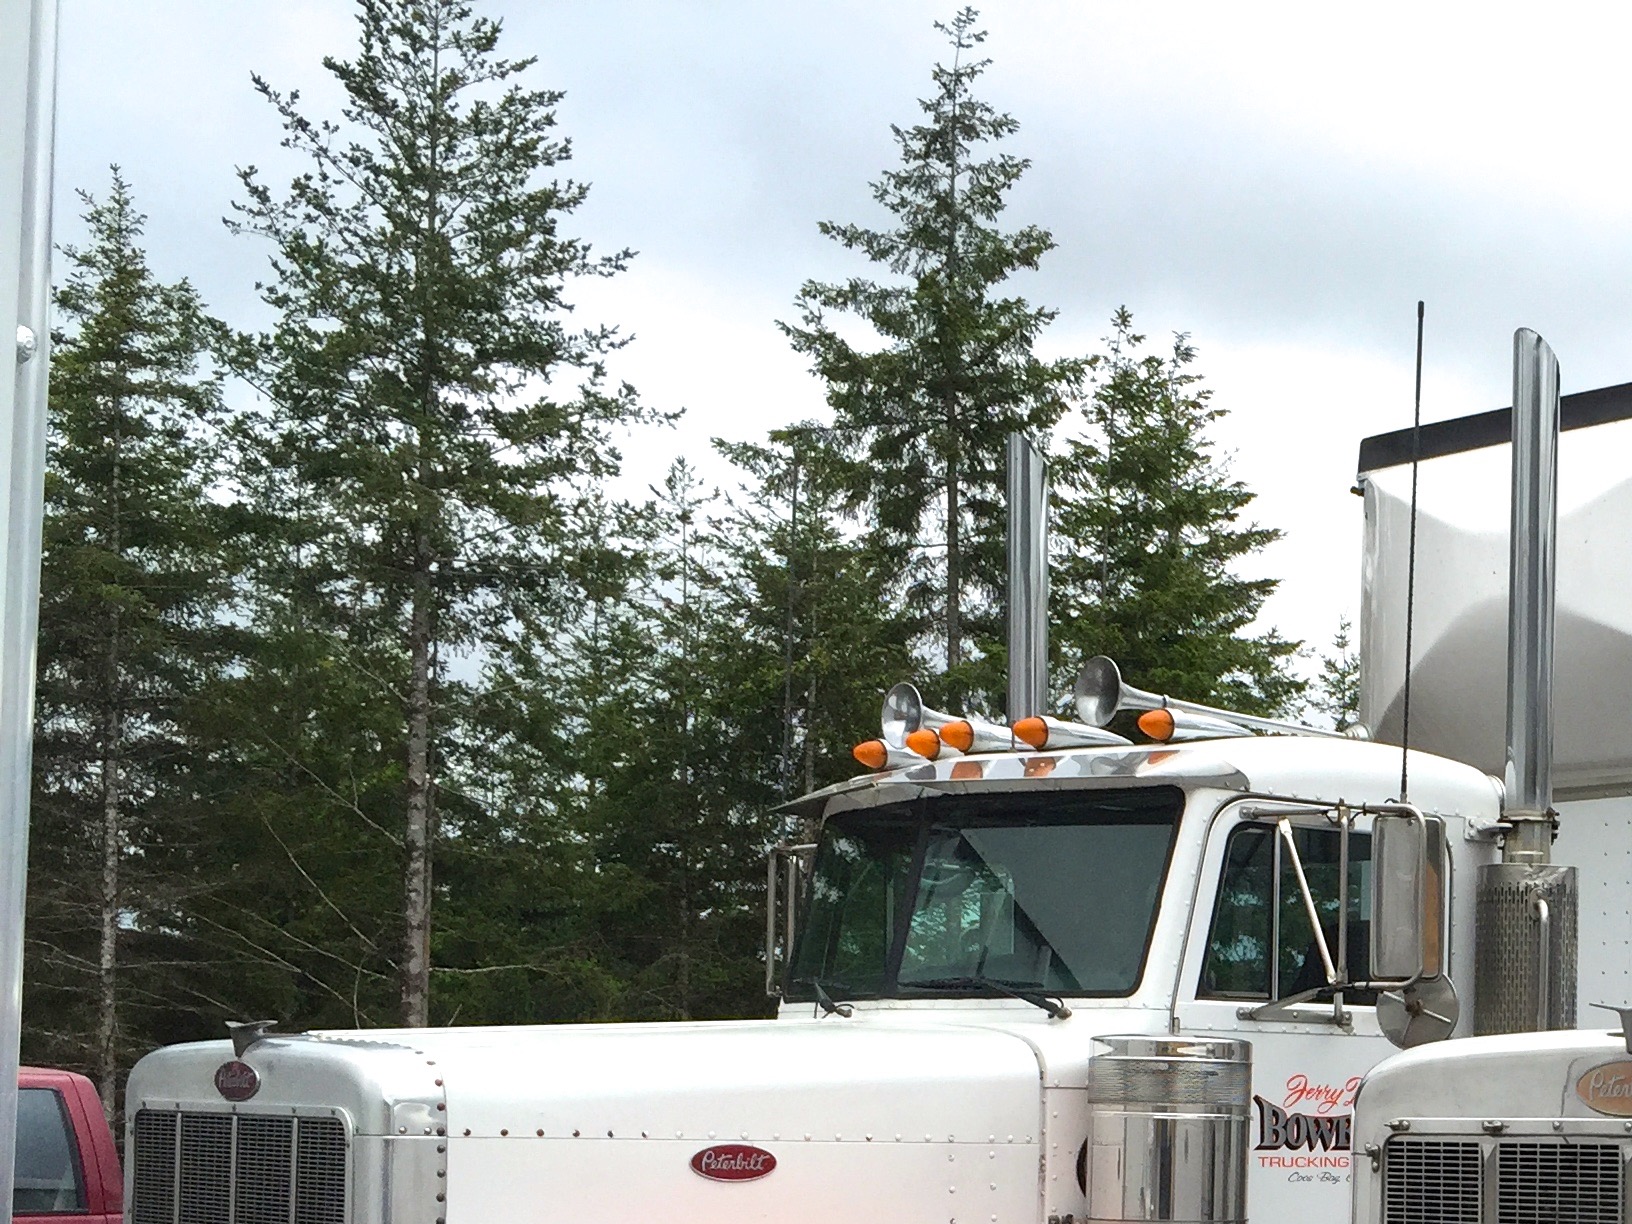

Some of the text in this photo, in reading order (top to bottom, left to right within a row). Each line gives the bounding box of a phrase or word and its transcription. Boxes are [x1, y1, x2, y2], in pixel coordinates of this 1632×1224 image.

[1283, 1074, 1344, 1114] Jerry
[701, 1150, 770, 1172] Peterbilt
[1258, 1156, 1350, 1168] TRUCKING
